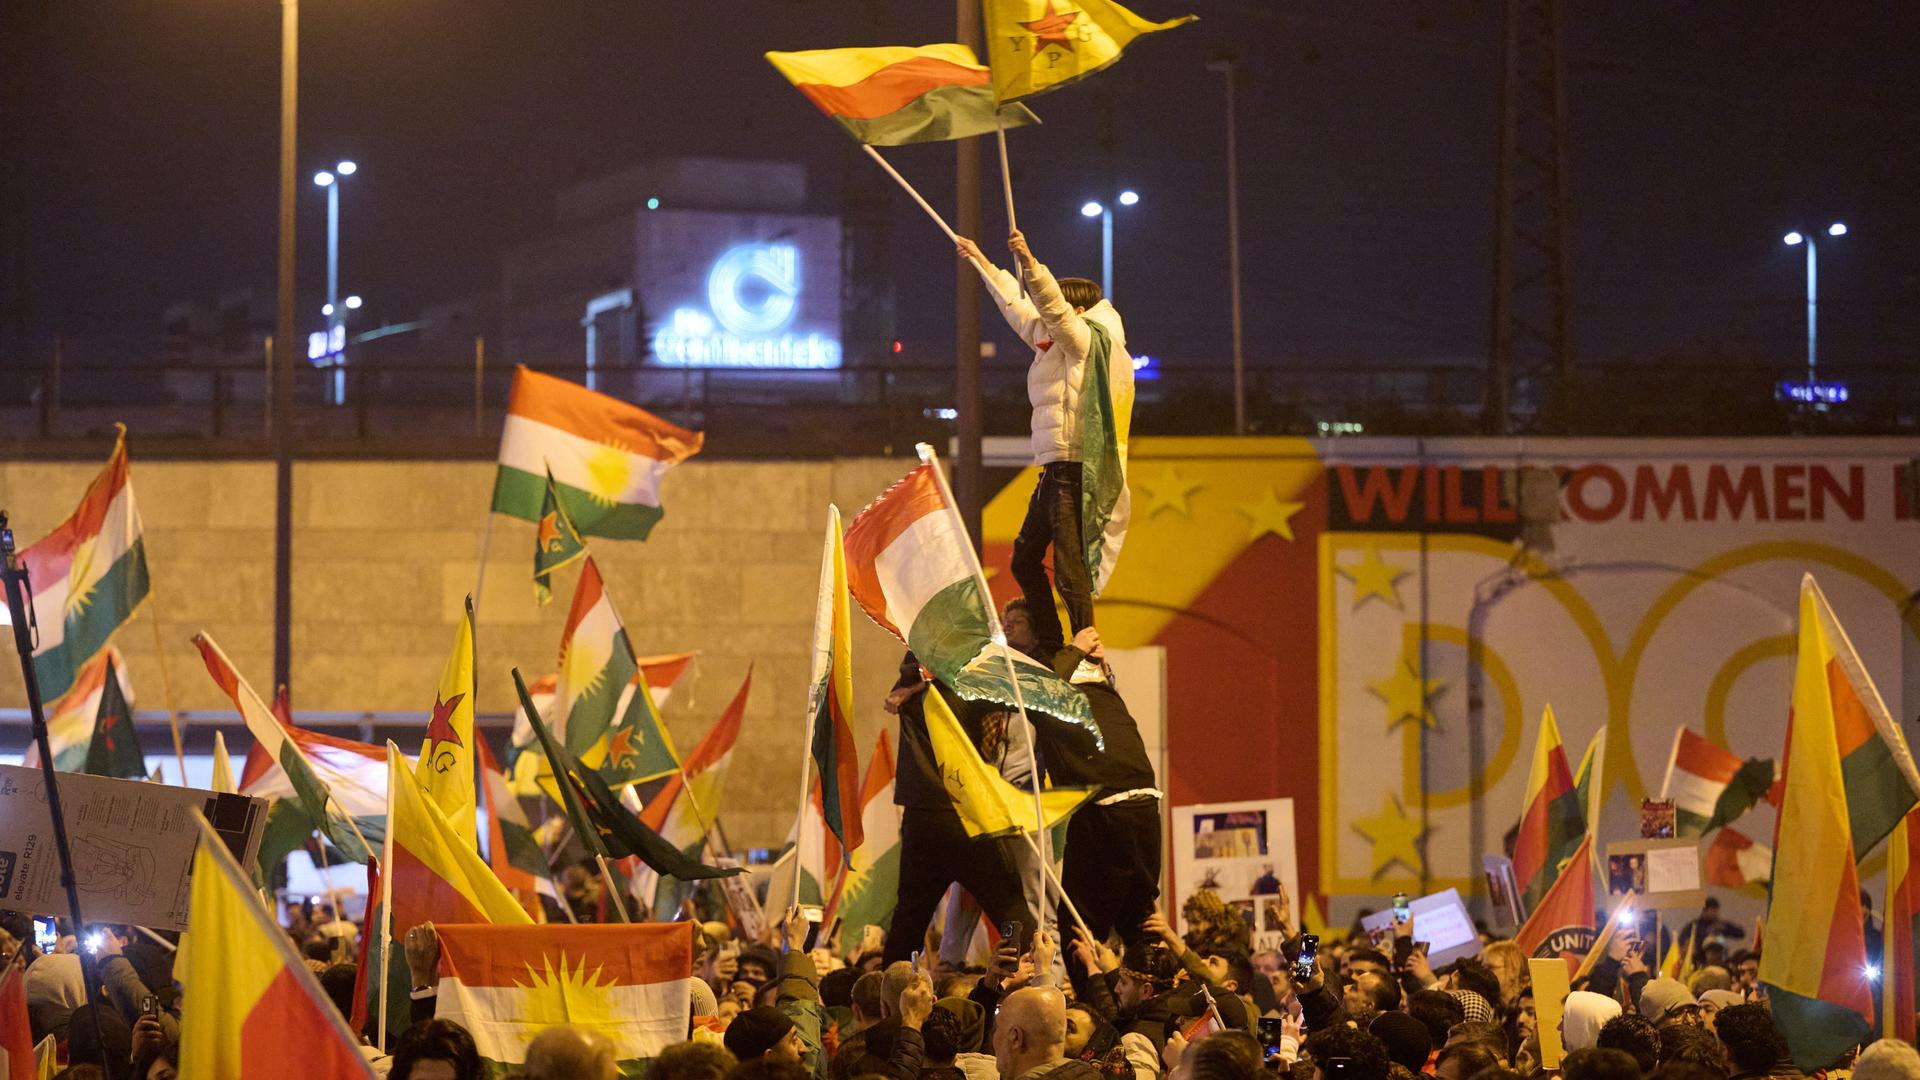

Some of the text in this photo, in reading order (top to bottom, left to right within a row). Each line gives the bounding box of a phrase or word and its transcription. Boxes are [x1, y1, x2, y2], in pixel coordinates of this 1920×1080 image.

[1047, 51, 1062, 69] P
[1337, 463, 1865, 524] WILLOMMEN
[14, 863, 30, 901] elevate
[23, 833, 37, 859] R129
